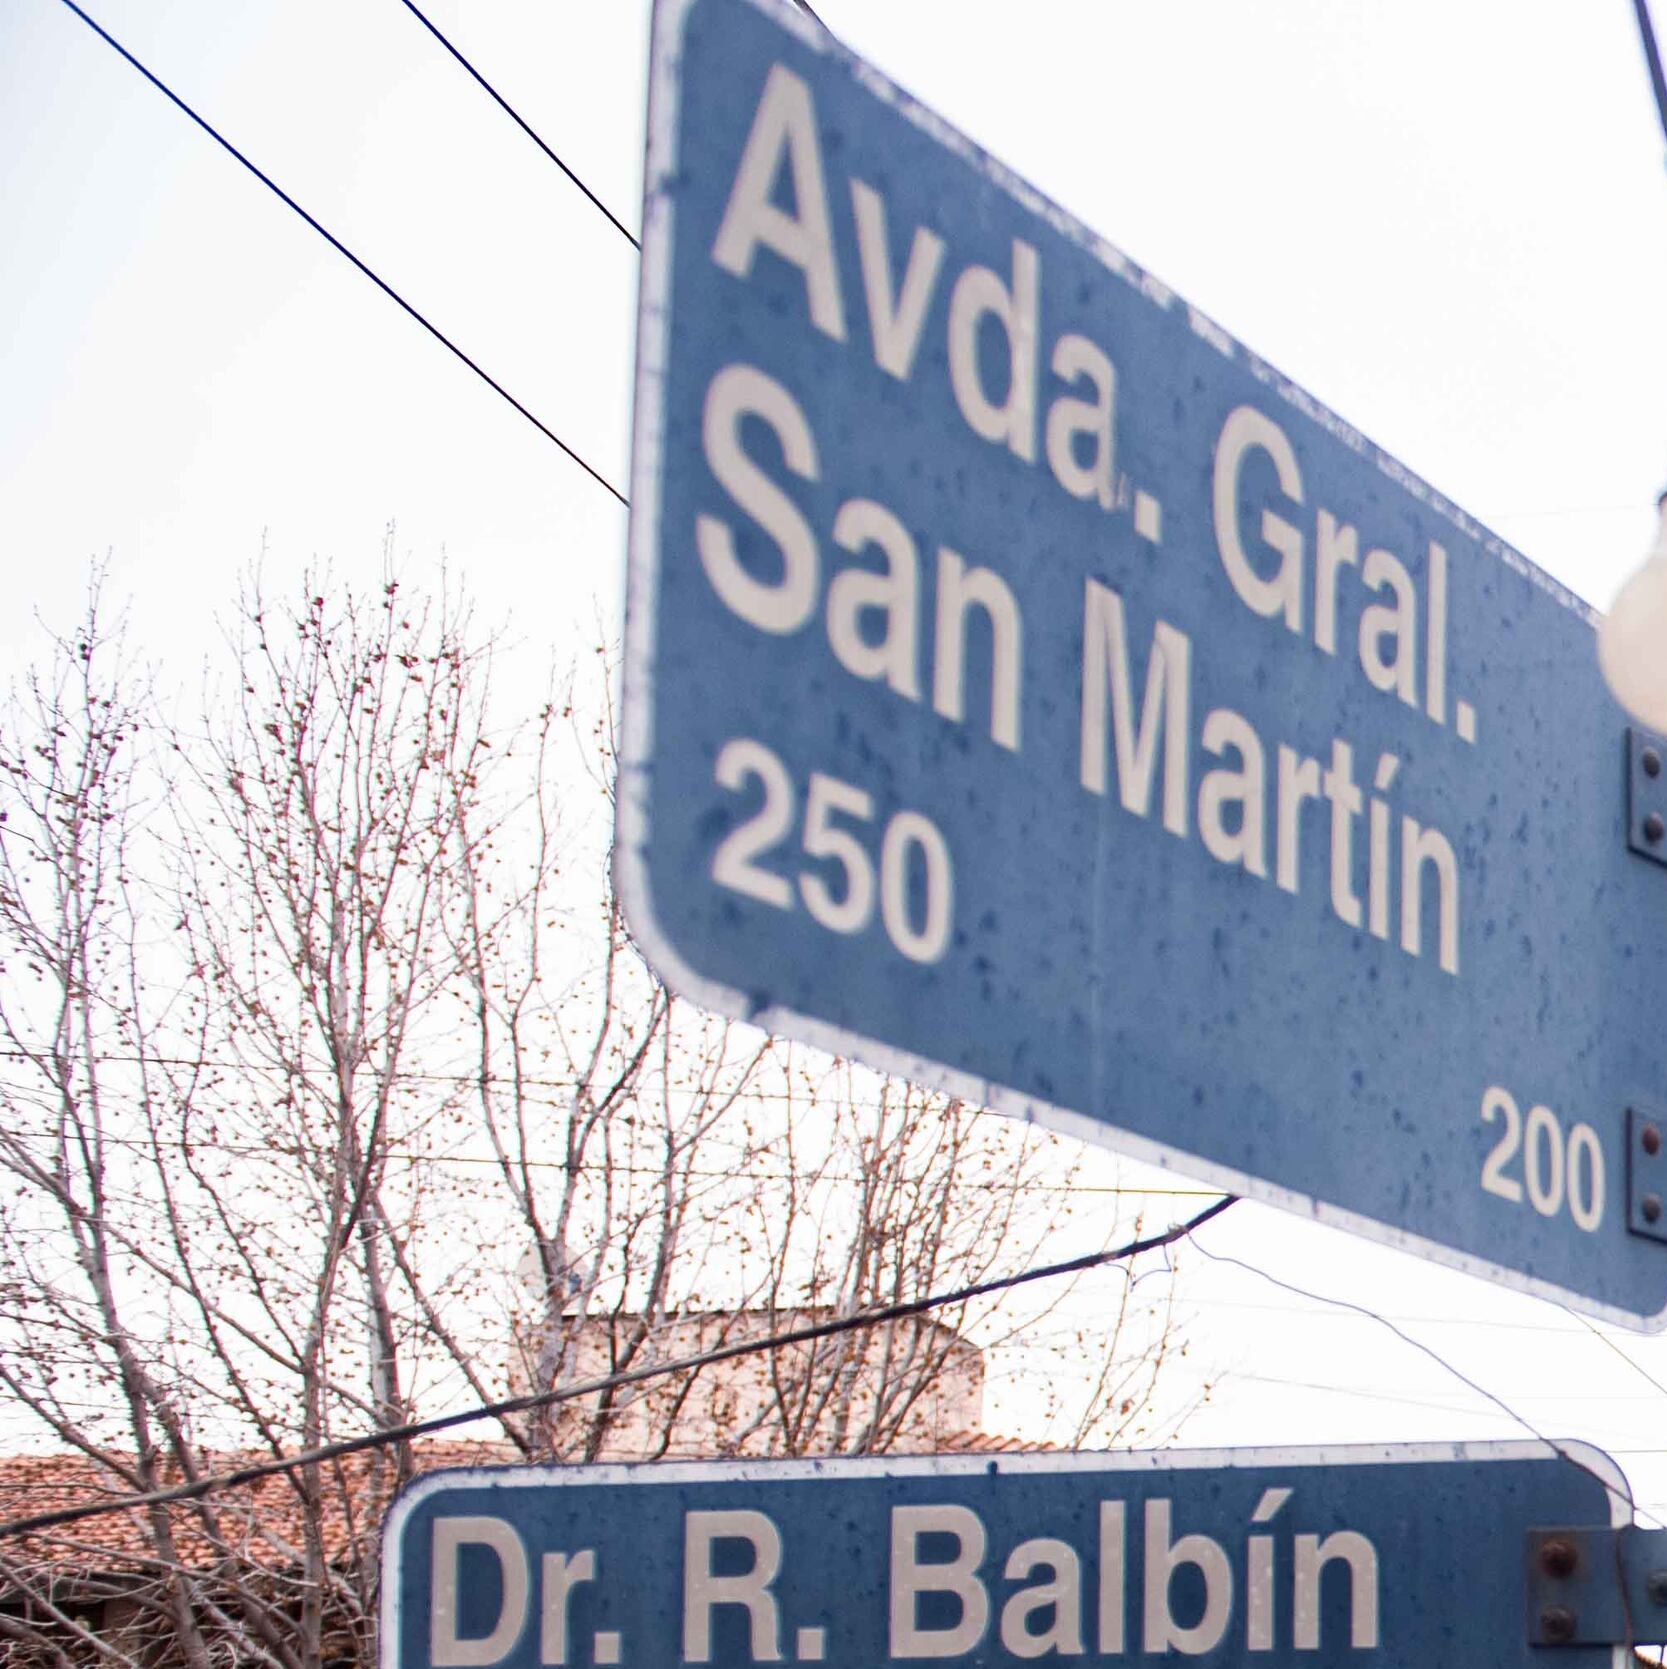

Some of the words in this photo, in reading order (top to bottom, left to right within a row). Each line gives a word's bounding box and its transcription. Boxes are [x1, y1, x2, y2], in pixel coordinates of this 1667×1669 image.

[712, 63, 1163, 545] Avda.
[1212, 404, 1479, 745] Gral.
[695, 364, 1022, 752] San
[1080, 578, 1460, 977] Martín
[712, 738, 955, 966] 250
[1480, 1085, 1605, 1234] 200
[428, 1514, 622, 1668] Dr.
[682, 1508, 826, 1663] R.
[888, 1487, 1380, 1660] Balbín
